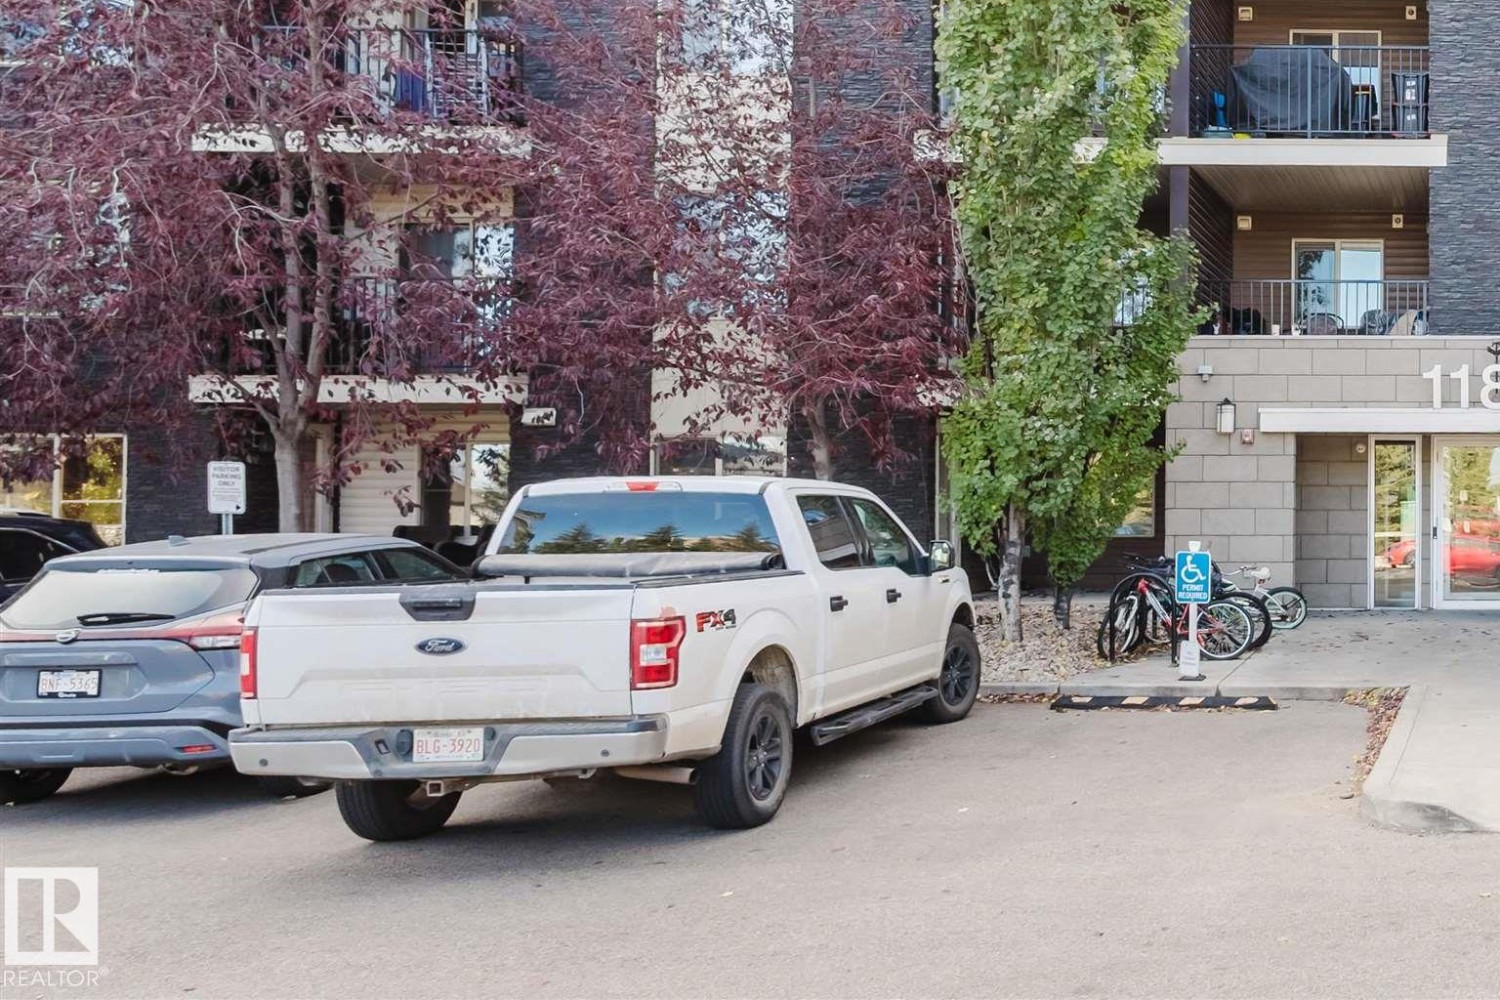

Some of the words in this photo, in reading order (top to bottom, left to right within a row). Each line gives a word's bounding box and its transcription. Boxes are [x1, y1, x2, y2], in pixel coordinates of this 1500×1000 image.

[1182, 584, 1204, 592] PERMIT
[1178, 591, 1208, 599] REQUIRED
[696, 609, 736, 632] FX4
[425, 640, 455, 652] Ford
